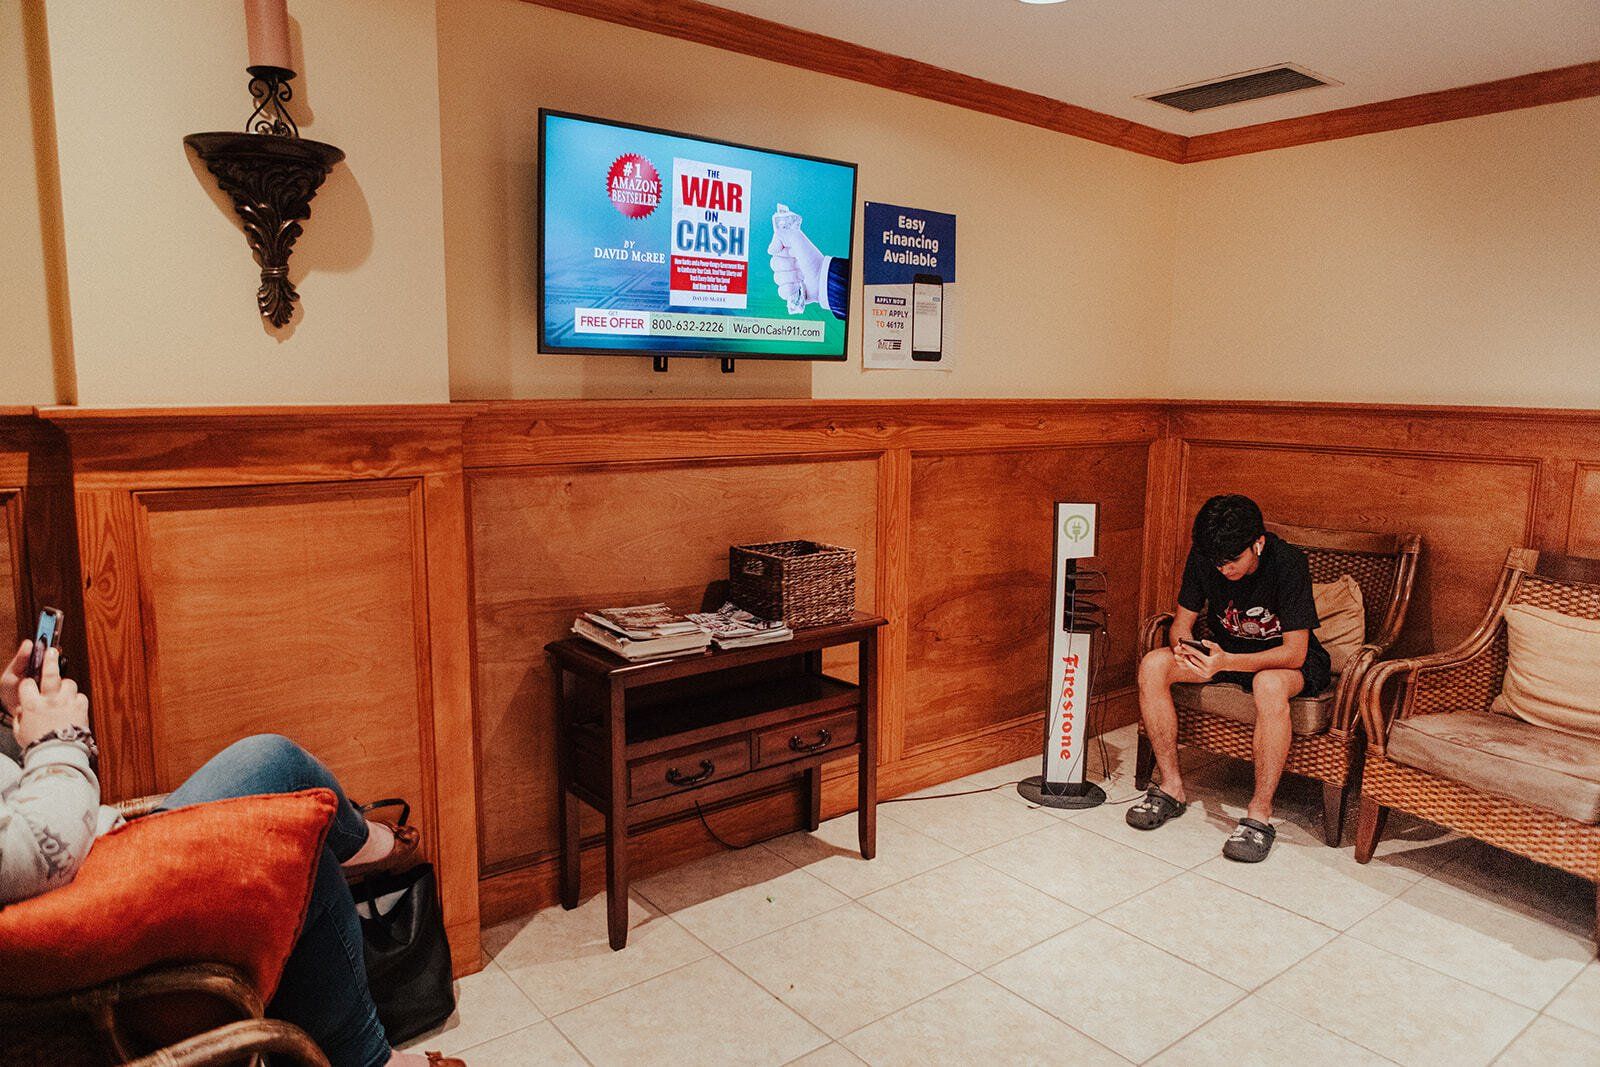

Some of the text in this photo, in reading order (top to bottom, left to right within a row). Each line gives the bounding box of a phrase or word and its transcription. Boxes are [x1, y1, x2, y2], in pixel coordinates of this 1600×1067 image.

[624, 162, 642, 178] #1
[707, 169, 720, 179] THE
[612, 176, 658, 194] AMAZON
[611, 189, 658, 206] BESTSELLER
[681, 174, 743, 213] WAR
[705, 210, 719, 222] ON
[898, 215, 926, 234] Easy
[624, 240, 636, 249] BY
[882, 230, 939, 253] Financing
[594, 247, 629, 260] DAVID
[883, 249, 938, 268] Available
[872, 309, 909, 319] TEXT APPLY
[580, 316, 645, 329] FREE OFFER
[652, 319, 724, 333] 800-632-2226
[733, 323, 820, 336] WarOnCash911.com
[876, 320, 905, 329] TO 46178
[1060, 654, 1079, 760] Firestone
